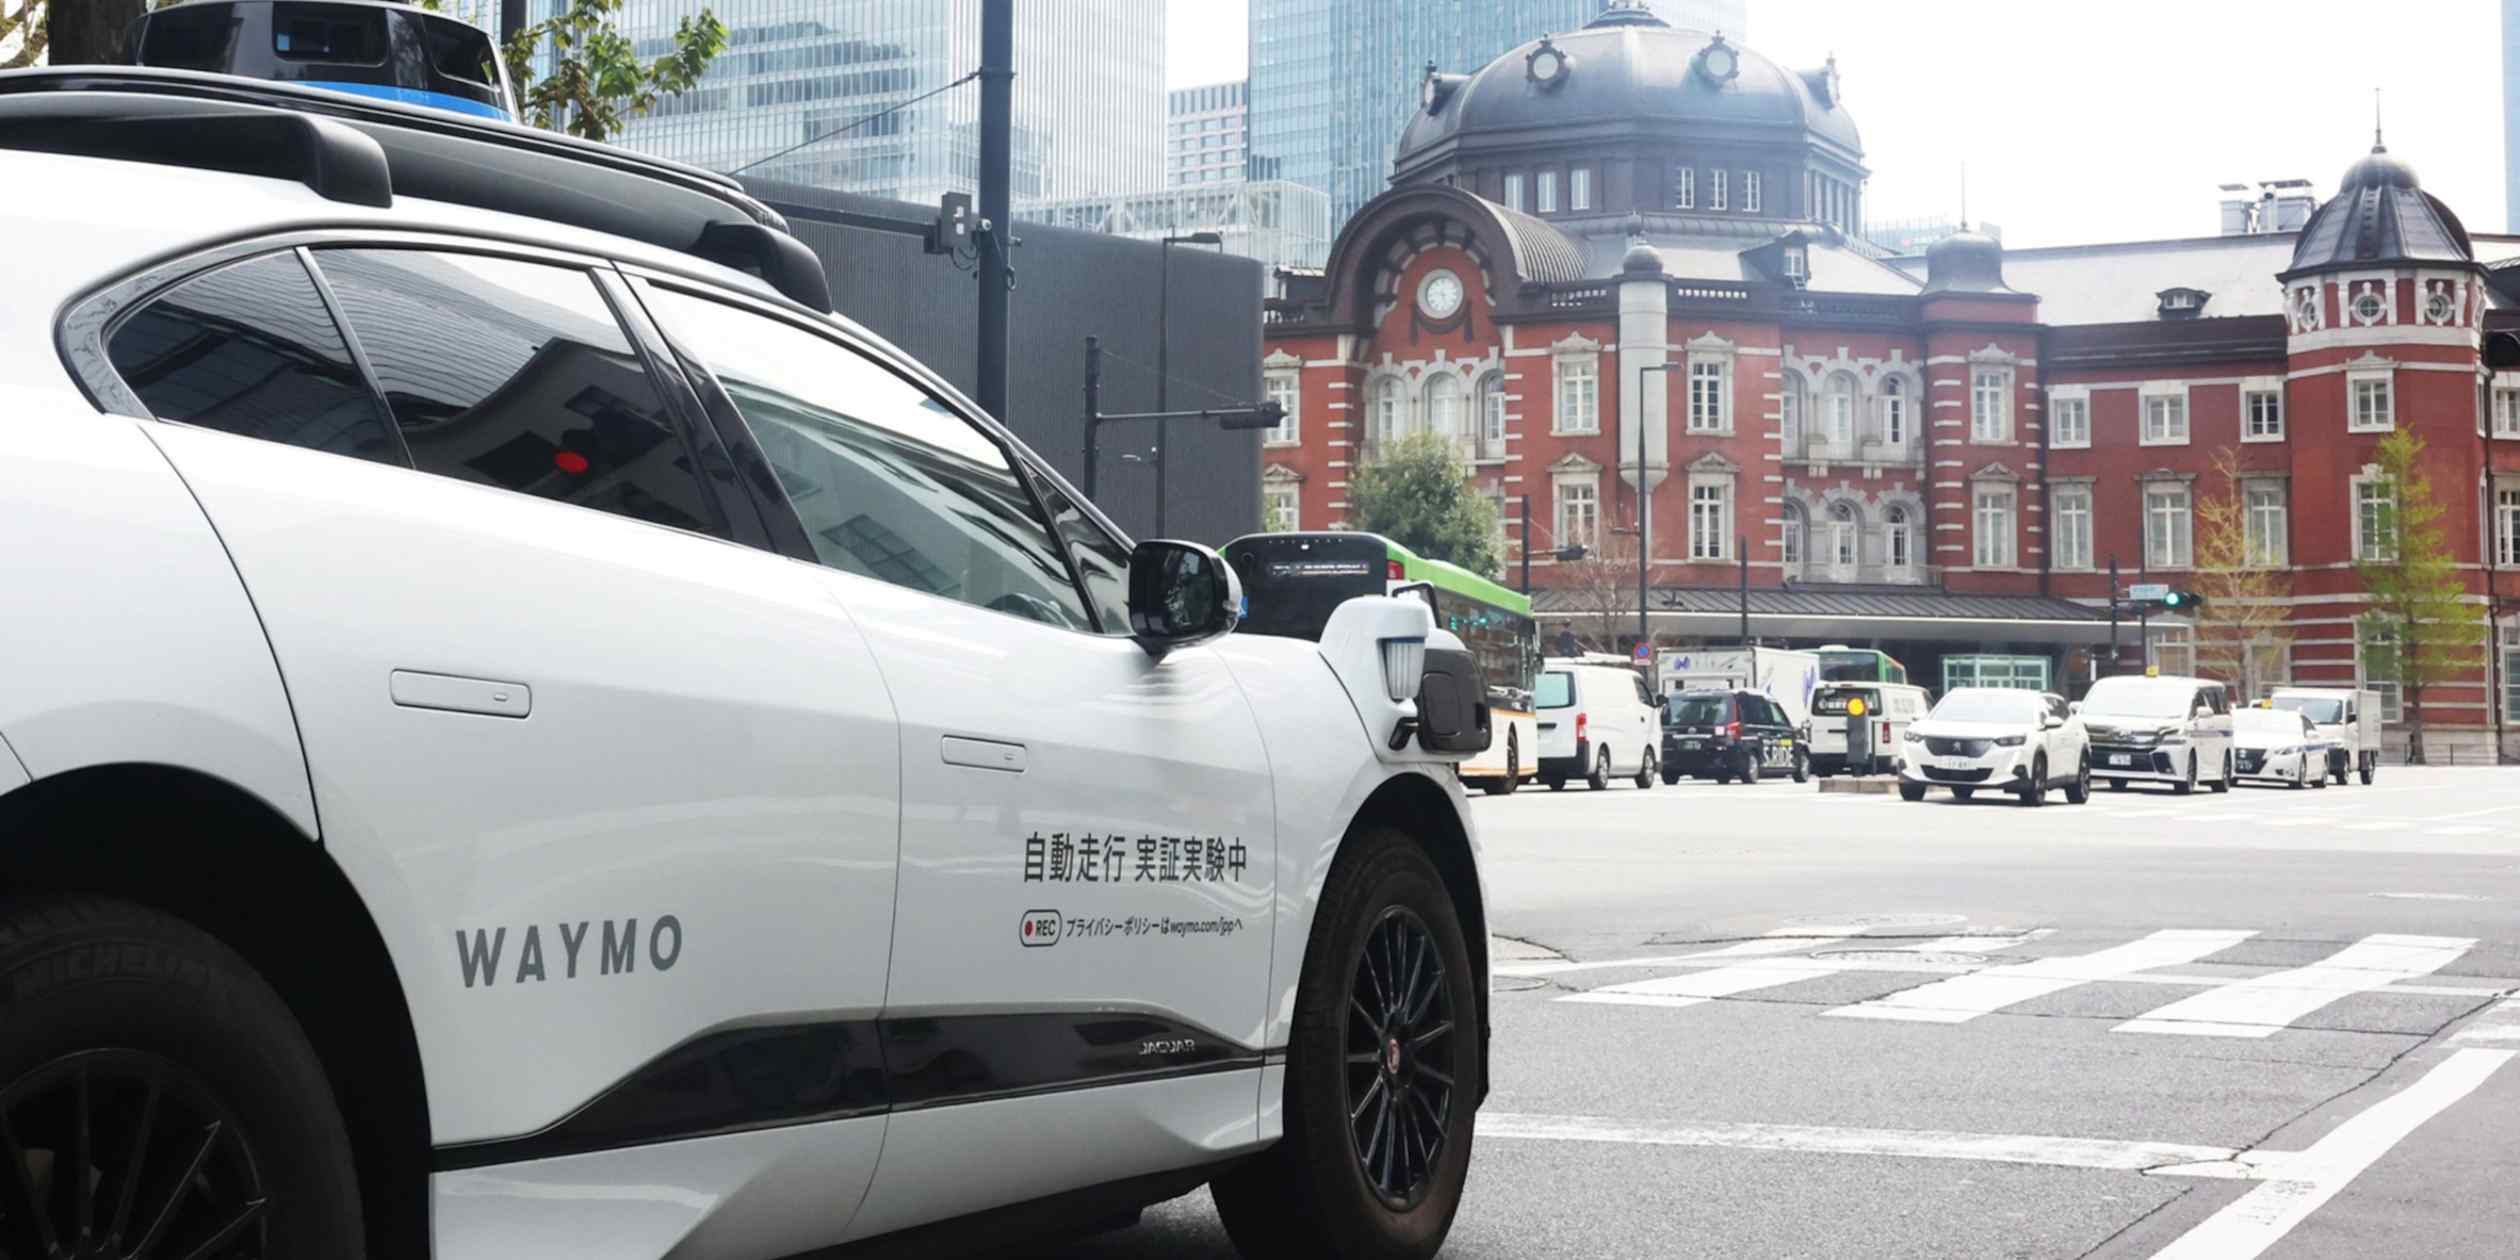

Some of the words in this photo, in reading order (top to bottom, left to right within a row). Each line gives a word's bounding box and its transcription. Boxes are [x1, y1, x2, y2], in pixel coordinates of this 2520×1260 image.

[1024, 831, 1126, 883] 自動走行
[1135, 834, 1247, 882] 実証実験中
[455, 914, 682, 988] WAYMO
[1035, 919, 1056, 937] REC
